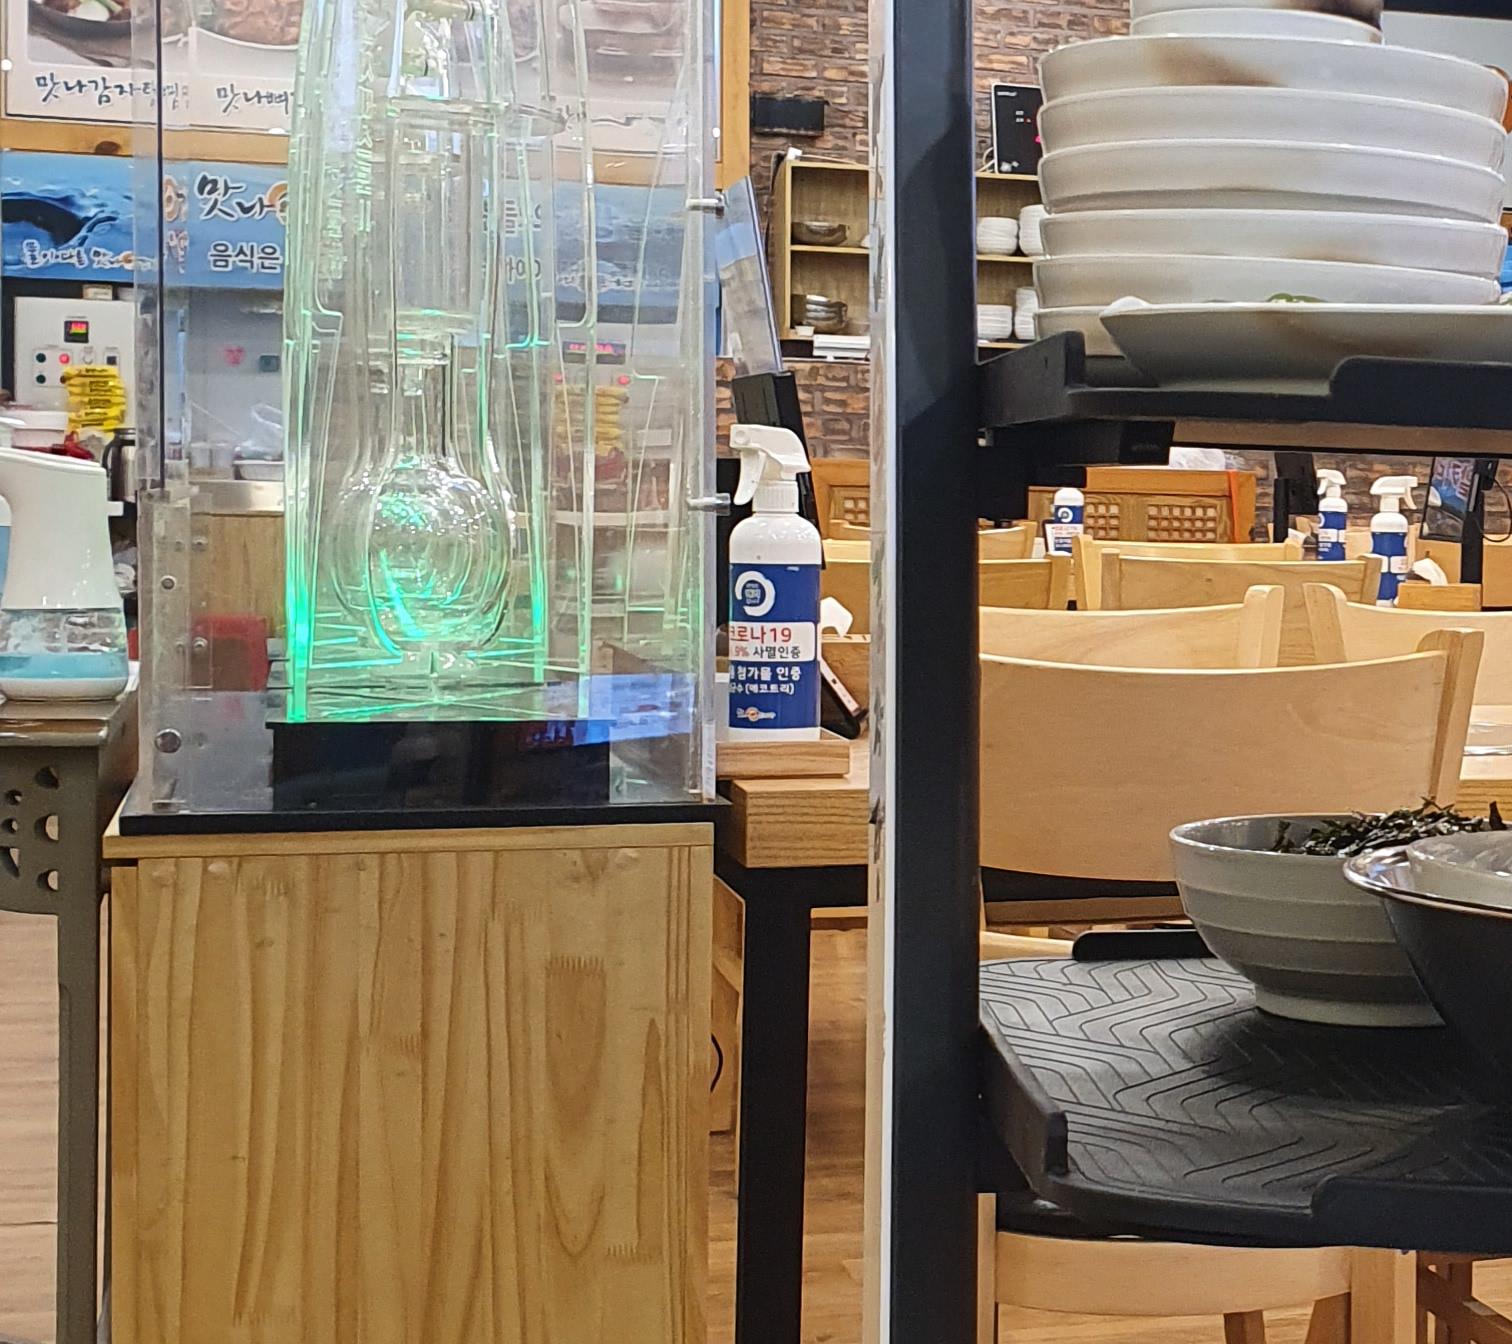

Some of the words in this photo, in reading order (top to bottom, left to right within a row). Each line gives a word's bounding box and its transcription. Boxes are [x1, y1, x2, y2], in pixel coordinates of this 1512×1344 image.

[209, 242, 282, 273] 음식은
[752, 645, 802, 659] 사멸인증
[776, 666, 802, 682] 인증
